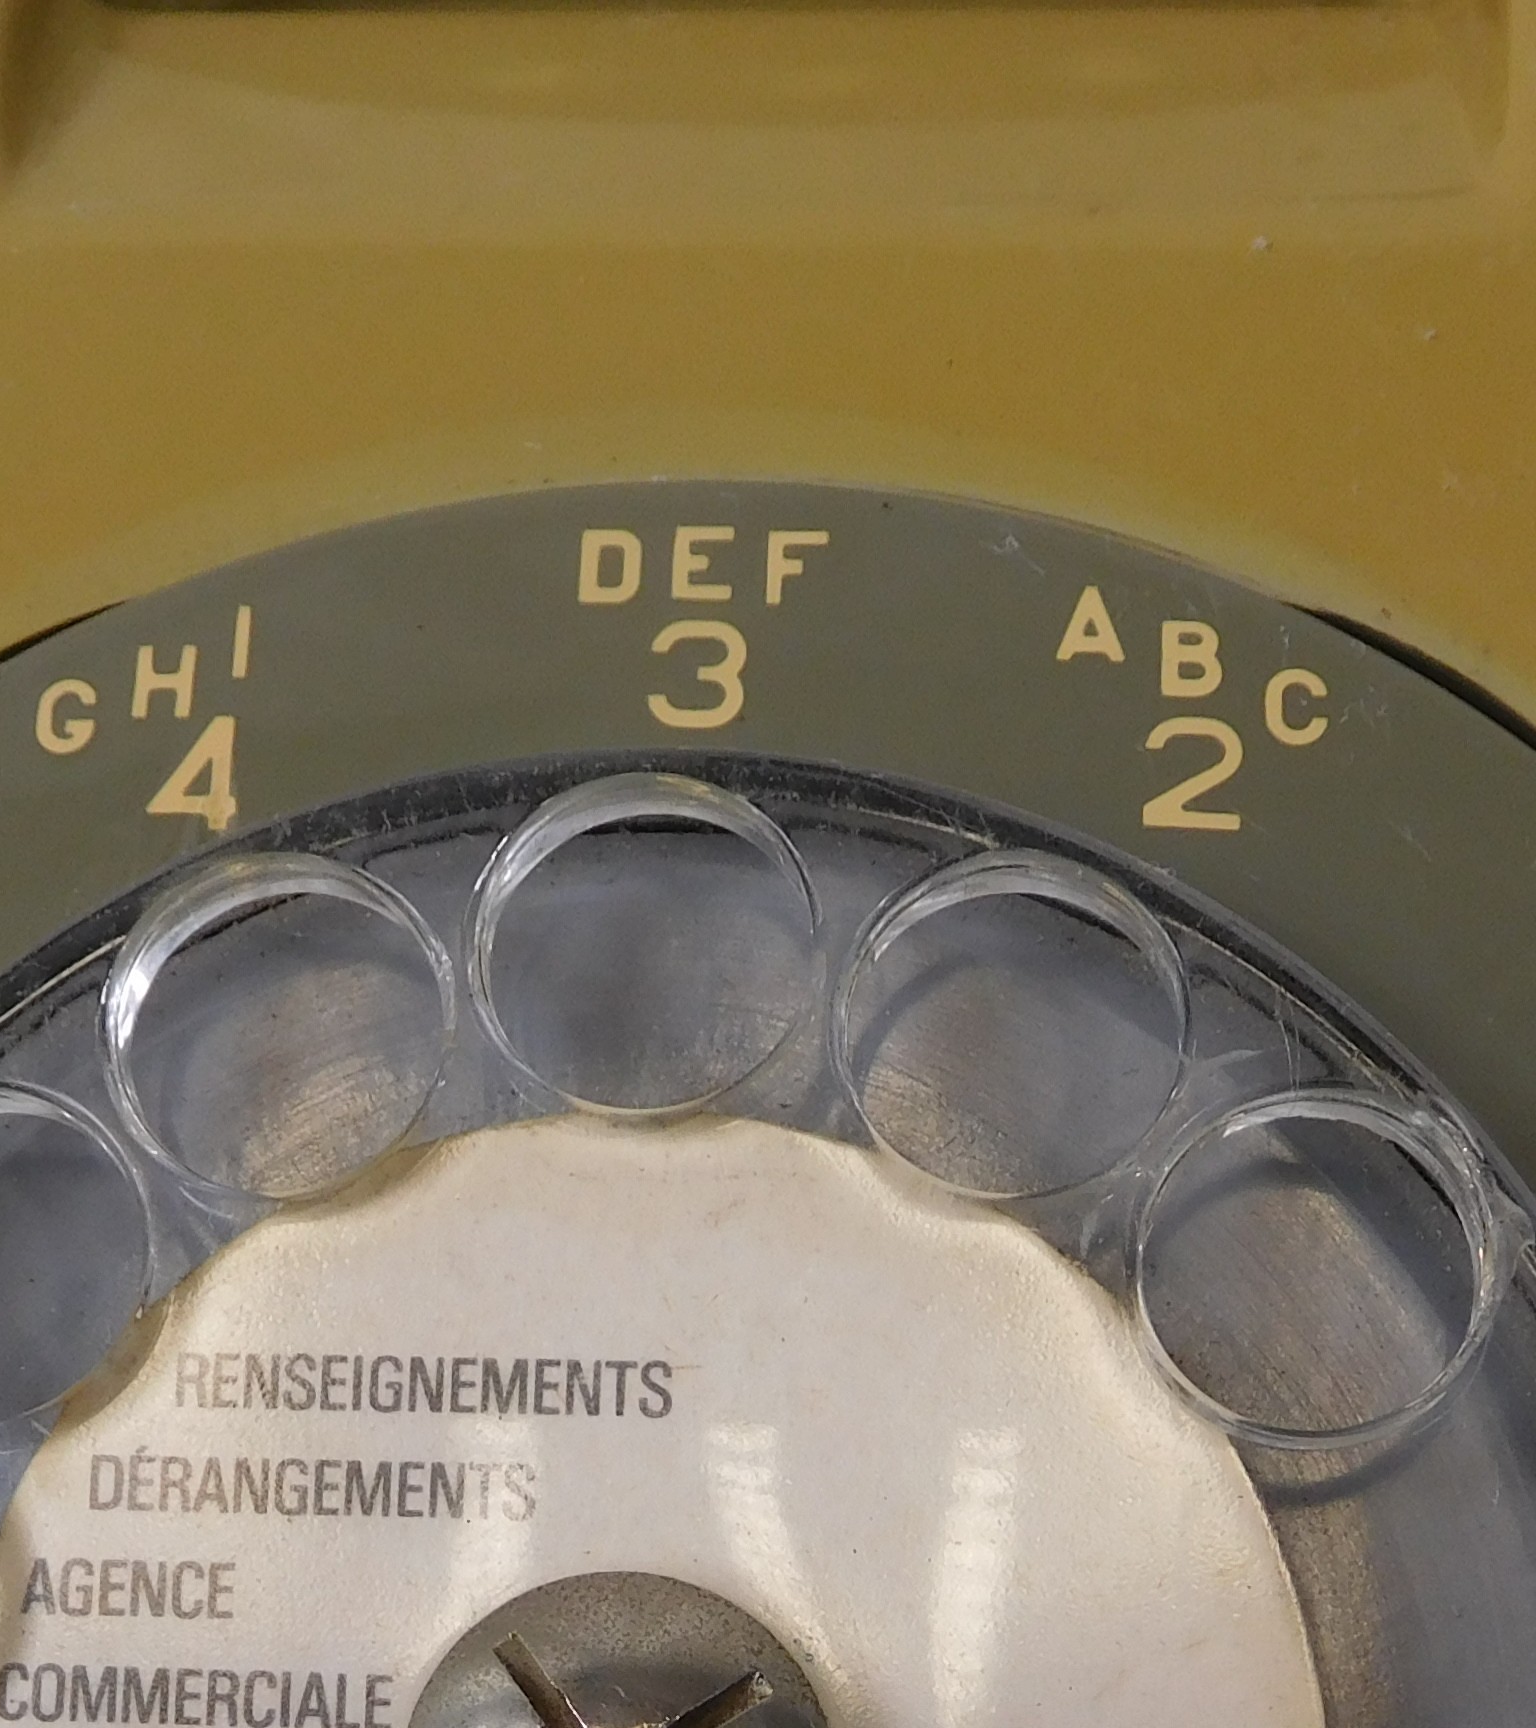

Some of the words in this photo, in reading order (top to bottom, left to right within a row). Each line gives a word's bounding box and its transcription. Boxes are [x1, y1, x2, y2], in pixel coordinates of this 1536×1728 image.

[650, 622, 747, 729] 3
[148, 716, 237, 830] 4
[1142, 716, 1243, 832] 2
[175, 1353, 673, 1419] RENSEIGNEMENTS
[89, 1445, 537, 1522] DÉRANGEMENTS
[20, 1559, 235, 1619] AGENCE
